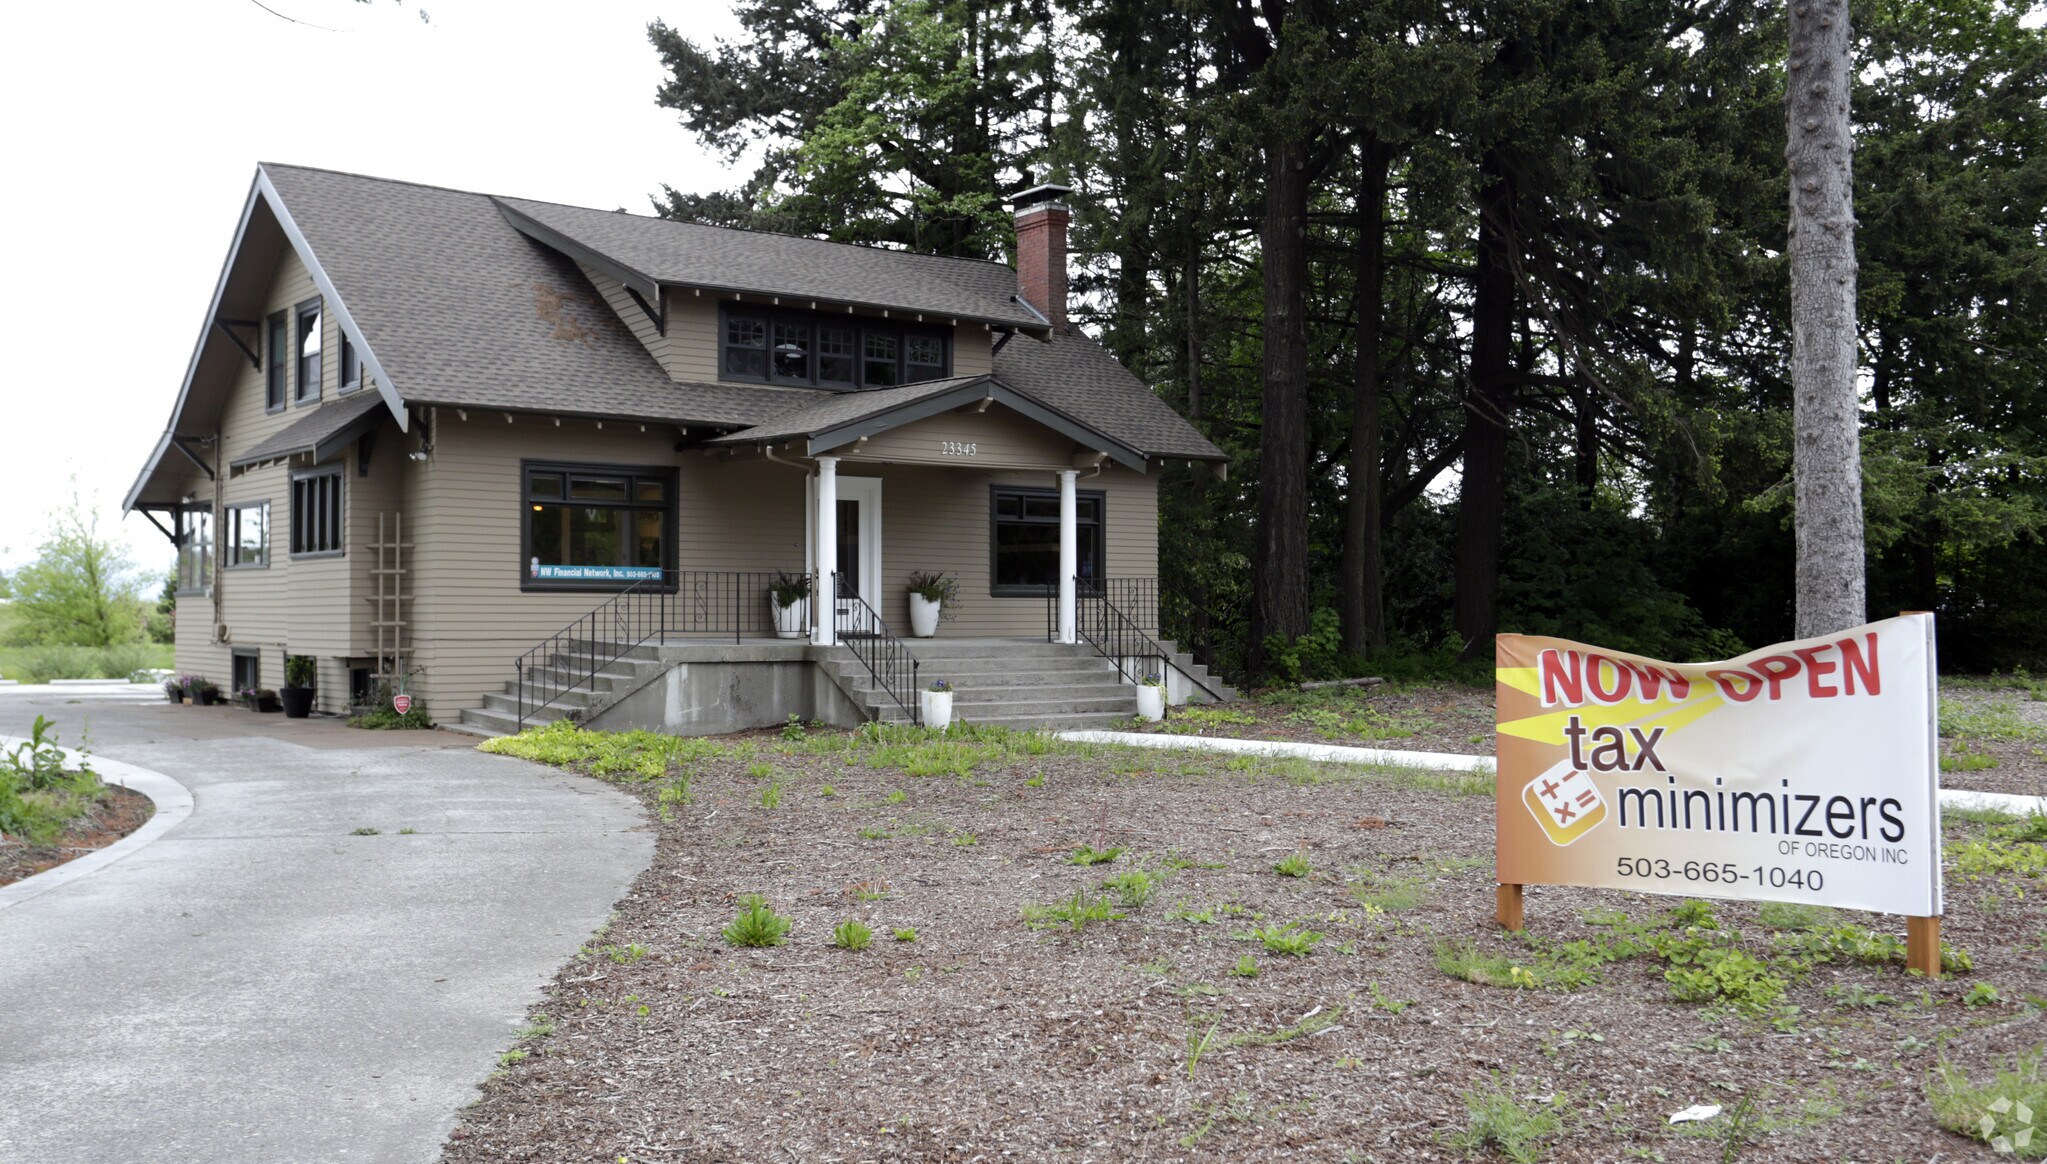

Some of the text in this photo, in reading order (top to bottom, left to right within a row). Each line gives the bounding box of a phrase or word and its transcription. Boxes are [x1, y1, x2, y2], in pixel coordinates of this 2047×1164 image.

[941, 441, 977, 456] 23345
[540, 567, 552, 576] NW
[554, 567, 582, 577] Financial
[584, 568, 611, 579] Network,
[613, 569, 624, 577] Inc.
[1539, 632, 1881, 706] NOW OPEN
[1564, 716, 1667, 772] tax
[1617, 775, 1905, 843] minimizers
[1778, 840, 1908, 865] OF OREGON INC
[1616, 857, 1824, 891] 503-665-1040
